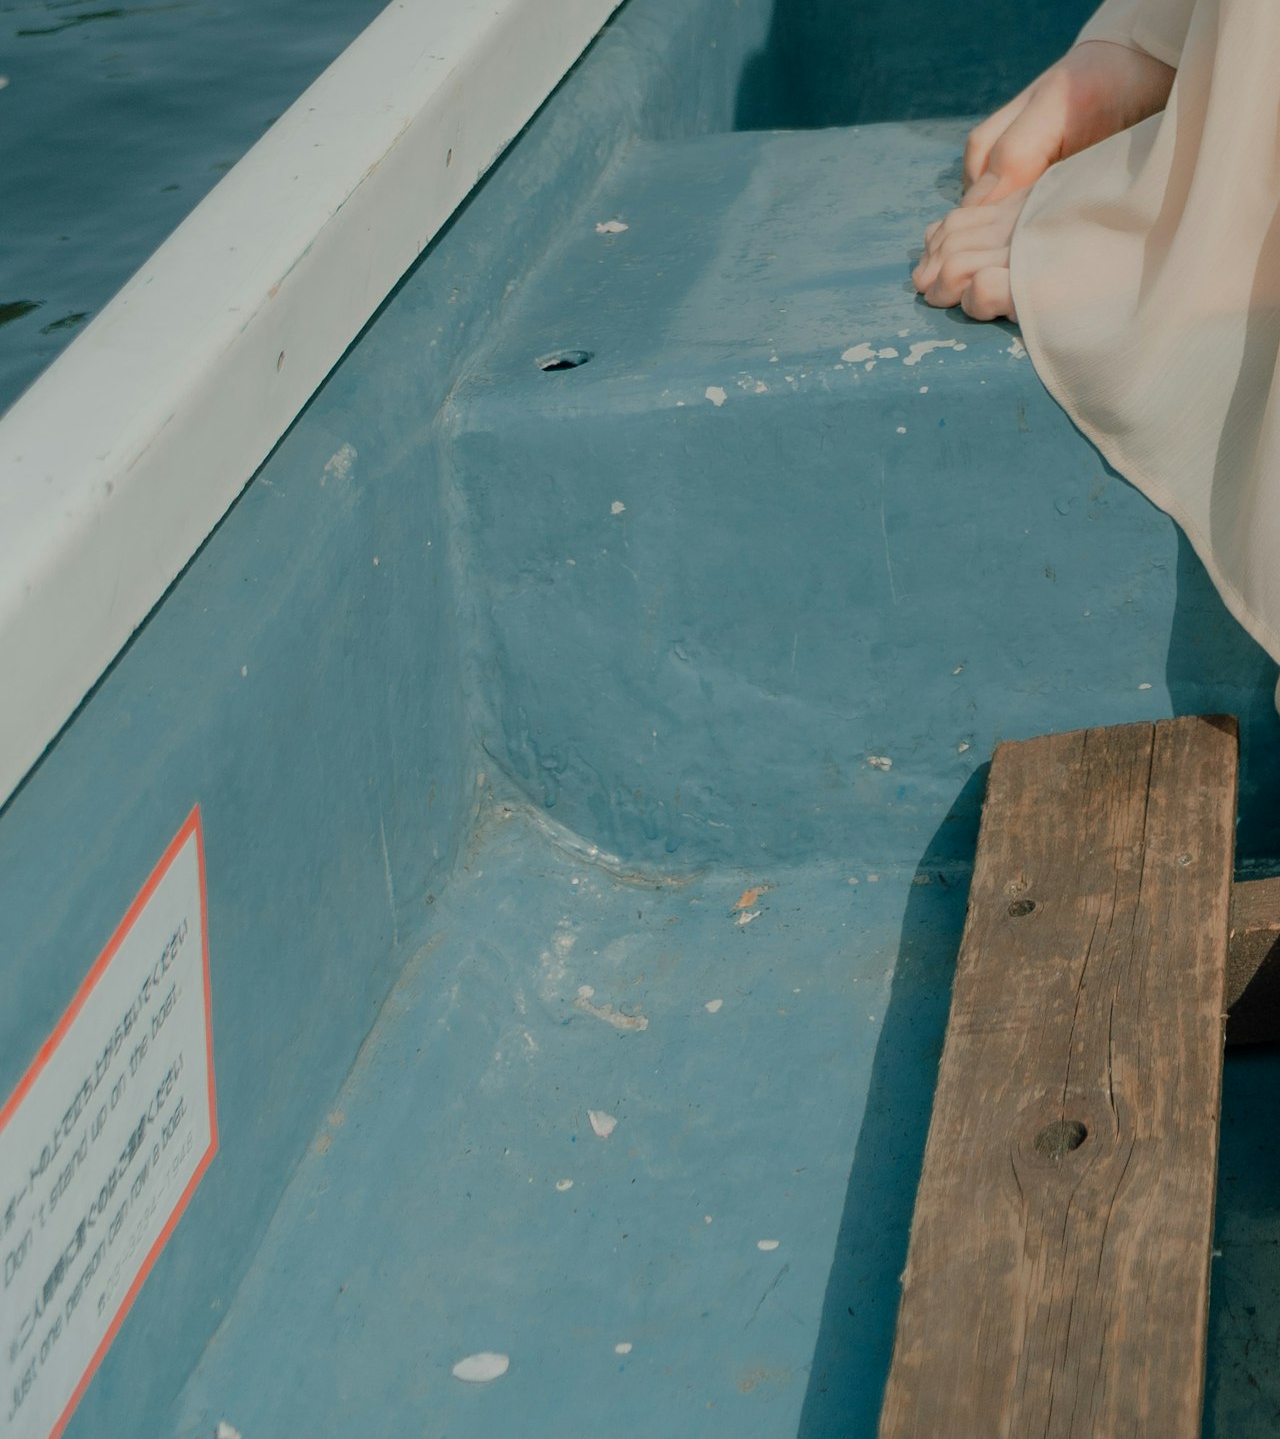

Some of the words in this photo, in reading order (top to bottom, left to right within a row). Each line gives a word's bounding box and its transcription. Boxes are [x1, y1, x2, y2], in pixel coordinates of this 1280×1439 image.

[49, 1128, 87, 1213] stand
[90, 1101, 107, 1143] up
[109, 1071, 126, 1111] on
[128, 1033, 148, 1078] the
[7, 1355, 37, 1422] Just
[39, 1313, 62, 1366] one
[64, 1237, 106, 1325] person
[107, 1198, 128, 1247] can
[129, 1154, 151, 1207] row
[152, 1141, 159, 1168] a
